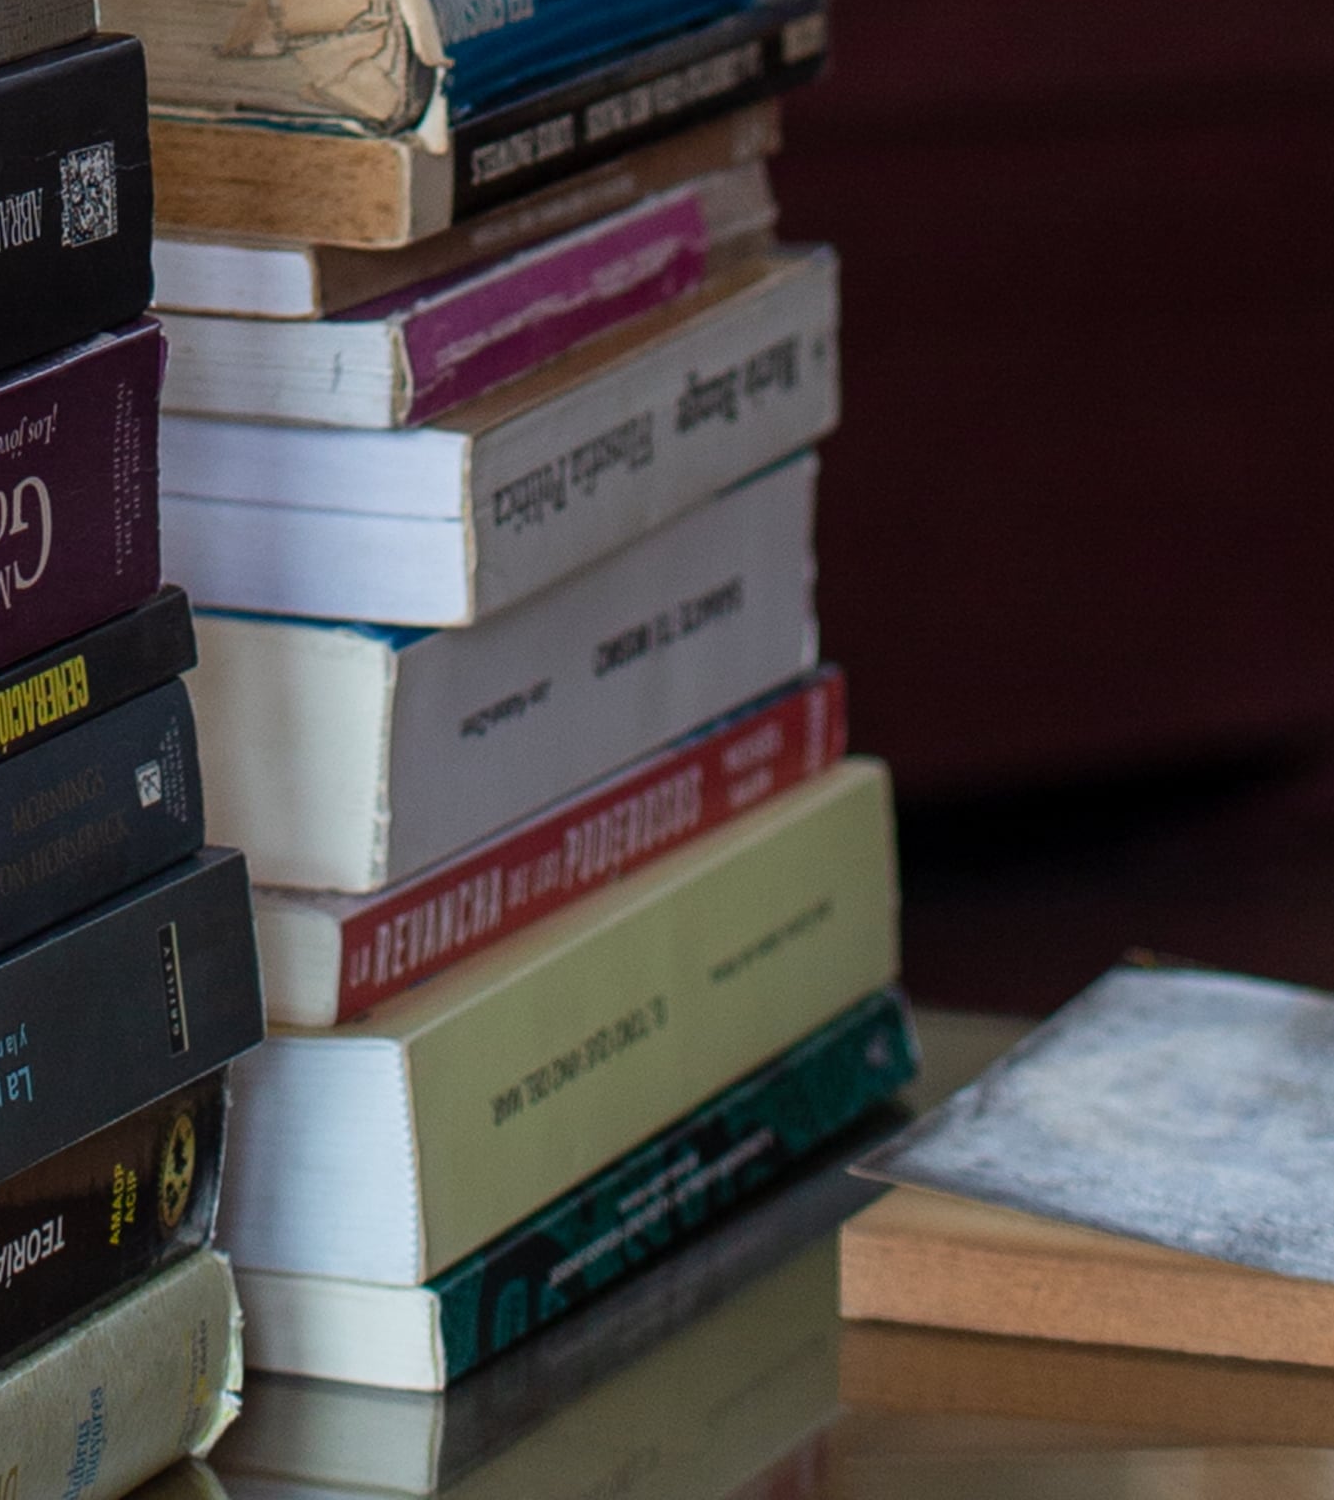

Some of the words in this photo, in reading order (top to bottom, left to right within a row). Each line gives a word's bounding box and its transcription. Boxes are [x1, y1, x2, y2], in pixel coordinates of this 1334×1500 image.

[28, 403, 58, 444] ¡Los
[12, 767, 106, 836] MORNINGS
[30, 811, 131, 881] HORSEBACK
[374, 868, 503, 988] REVANCHA
[6, 1035, 18, 1058] la
[21, 1023, 28, 1048] y
[6, 1064, 33, 1103] La
